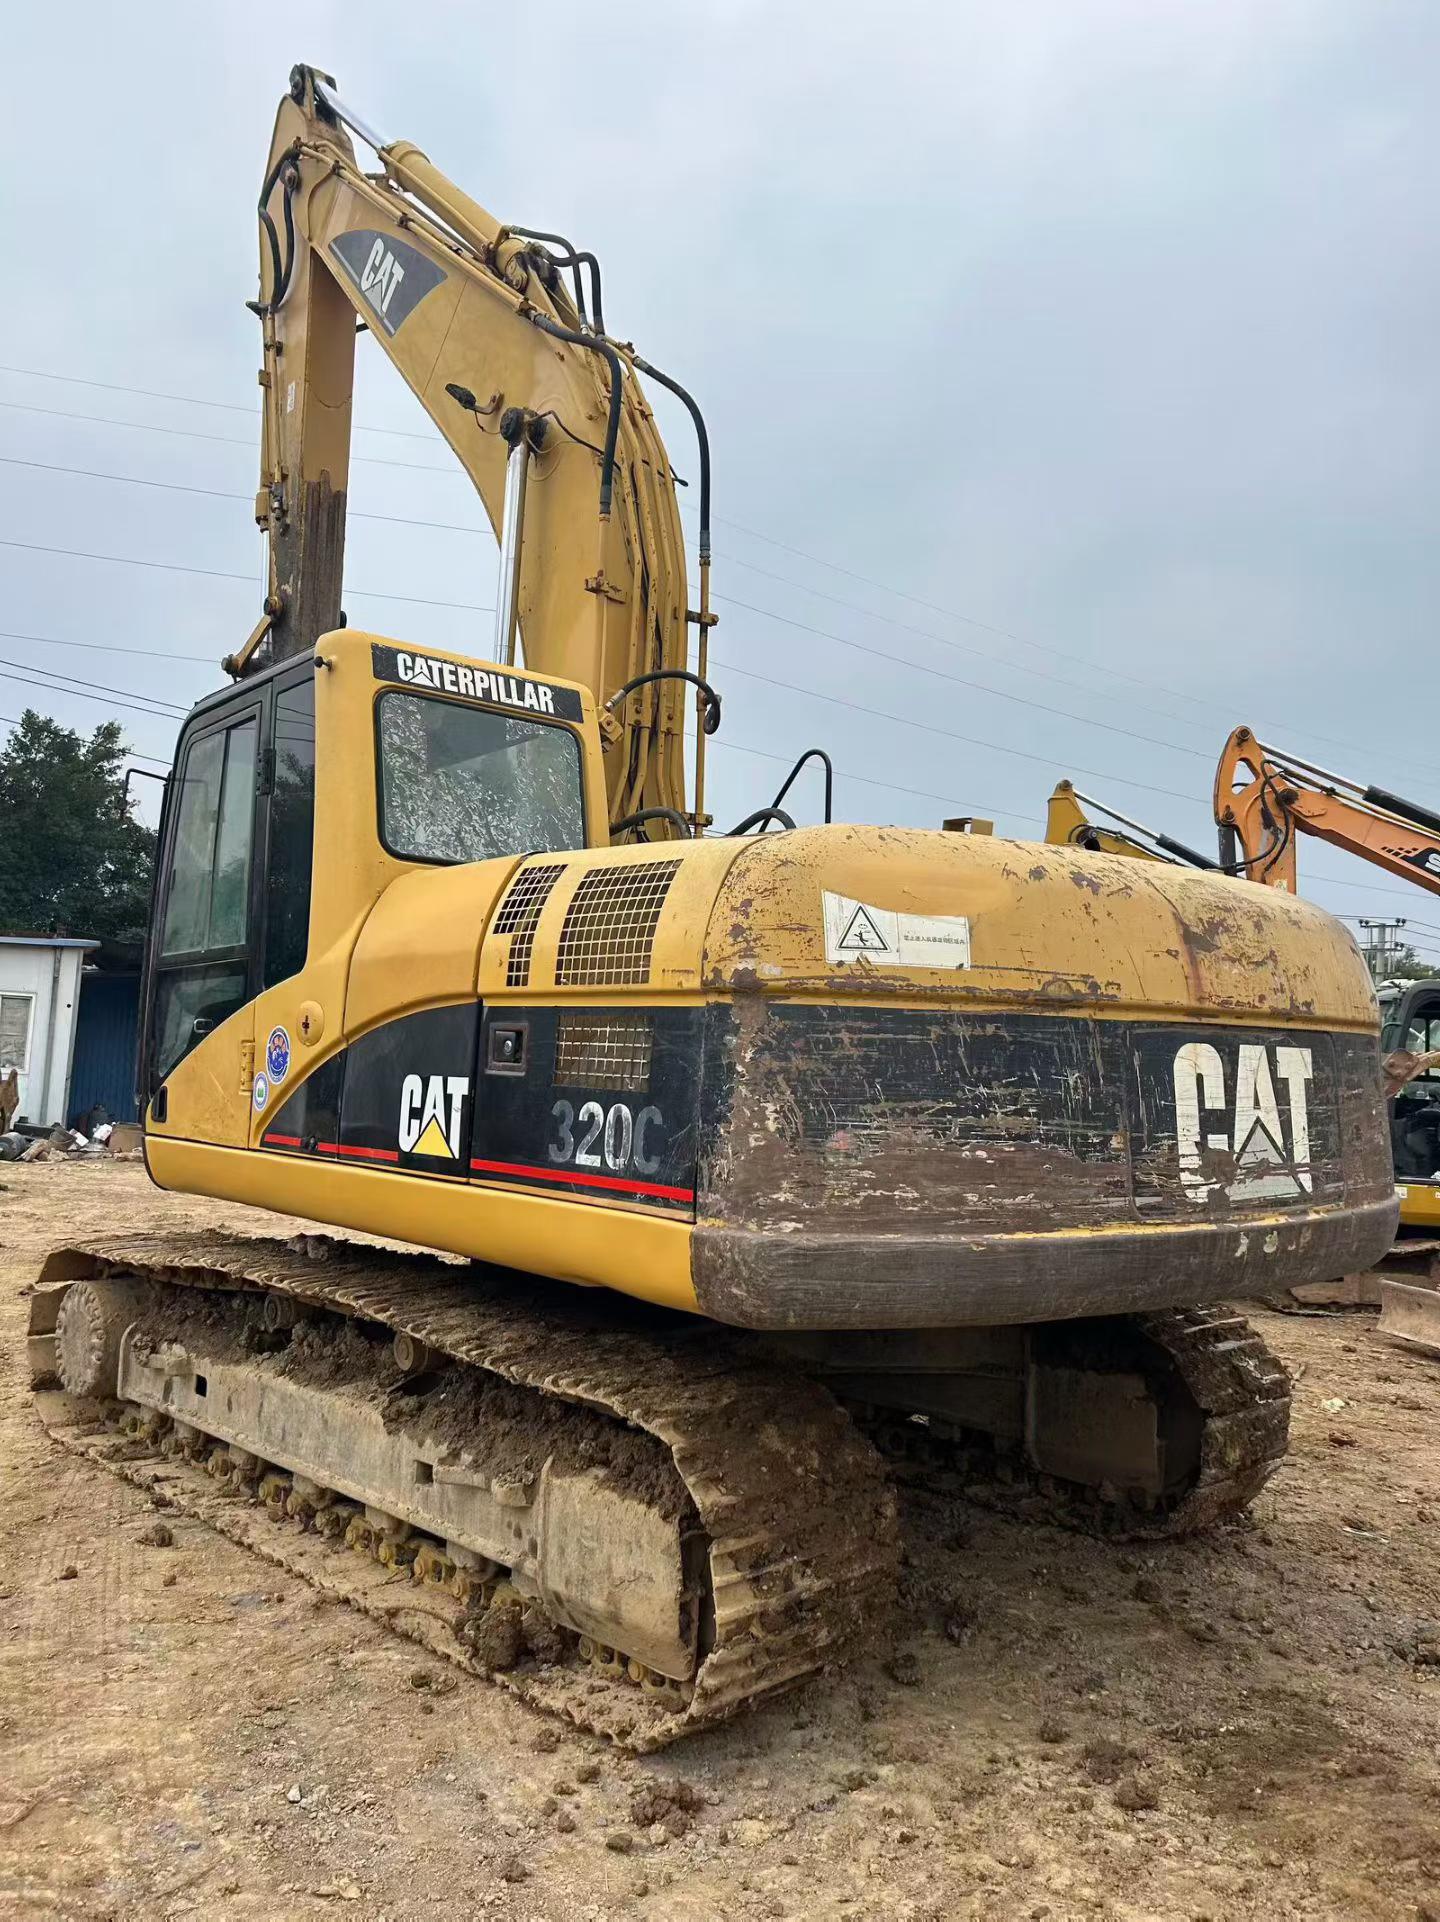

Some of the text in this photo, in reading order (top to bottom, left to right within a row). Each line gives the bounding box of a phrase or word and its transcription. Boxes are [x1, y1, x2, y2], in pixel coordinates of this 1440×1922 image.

[360, 238, 405, 315] CAT
[396, 652, 555, 714] CATERPILLAR
[398, 1073, 470, 1160] CAT
[548, 1099, 663, 1174] 320C
[1173, 1042, 1314, 1204] CAT
